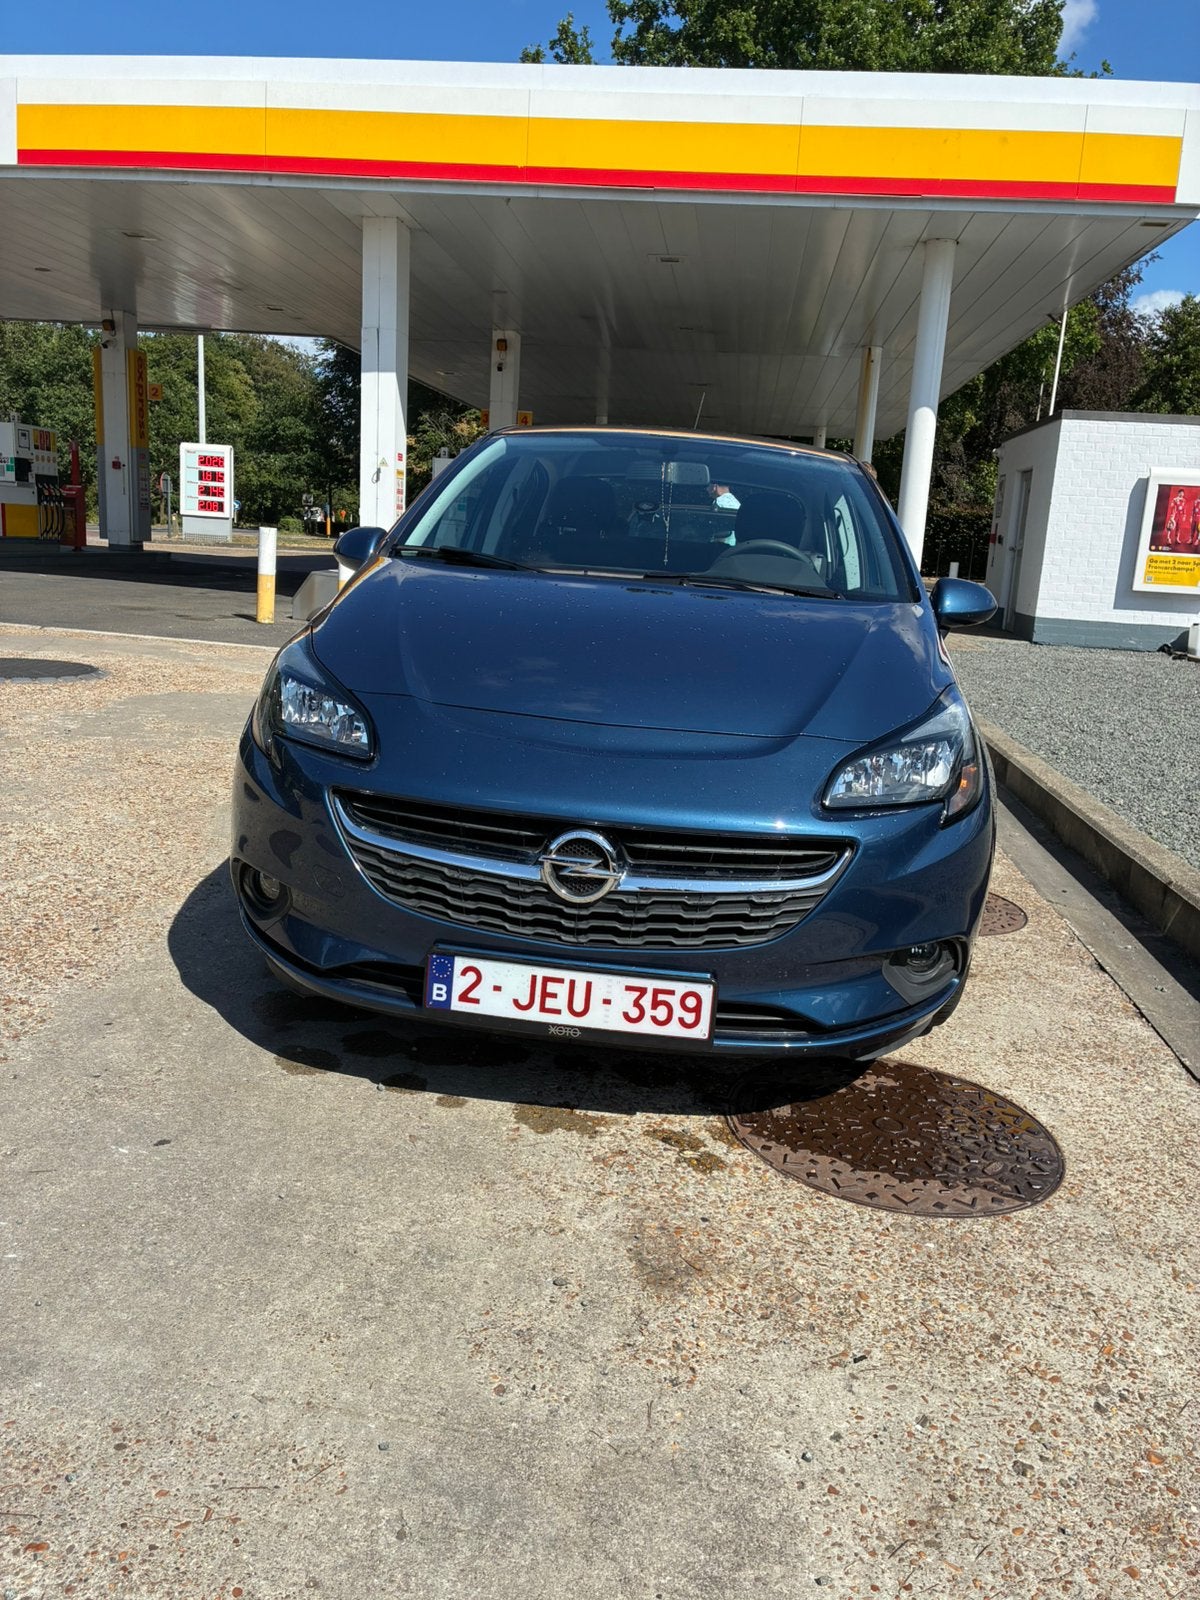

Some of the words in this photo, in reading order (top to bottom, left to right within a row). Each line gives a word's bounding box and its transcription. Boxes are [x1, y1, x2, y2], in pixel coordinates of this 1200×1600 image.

[151, 387, 159, 397] 2
[521, 415, 529, 425] 4
[432, 983, 447, 1001] B
